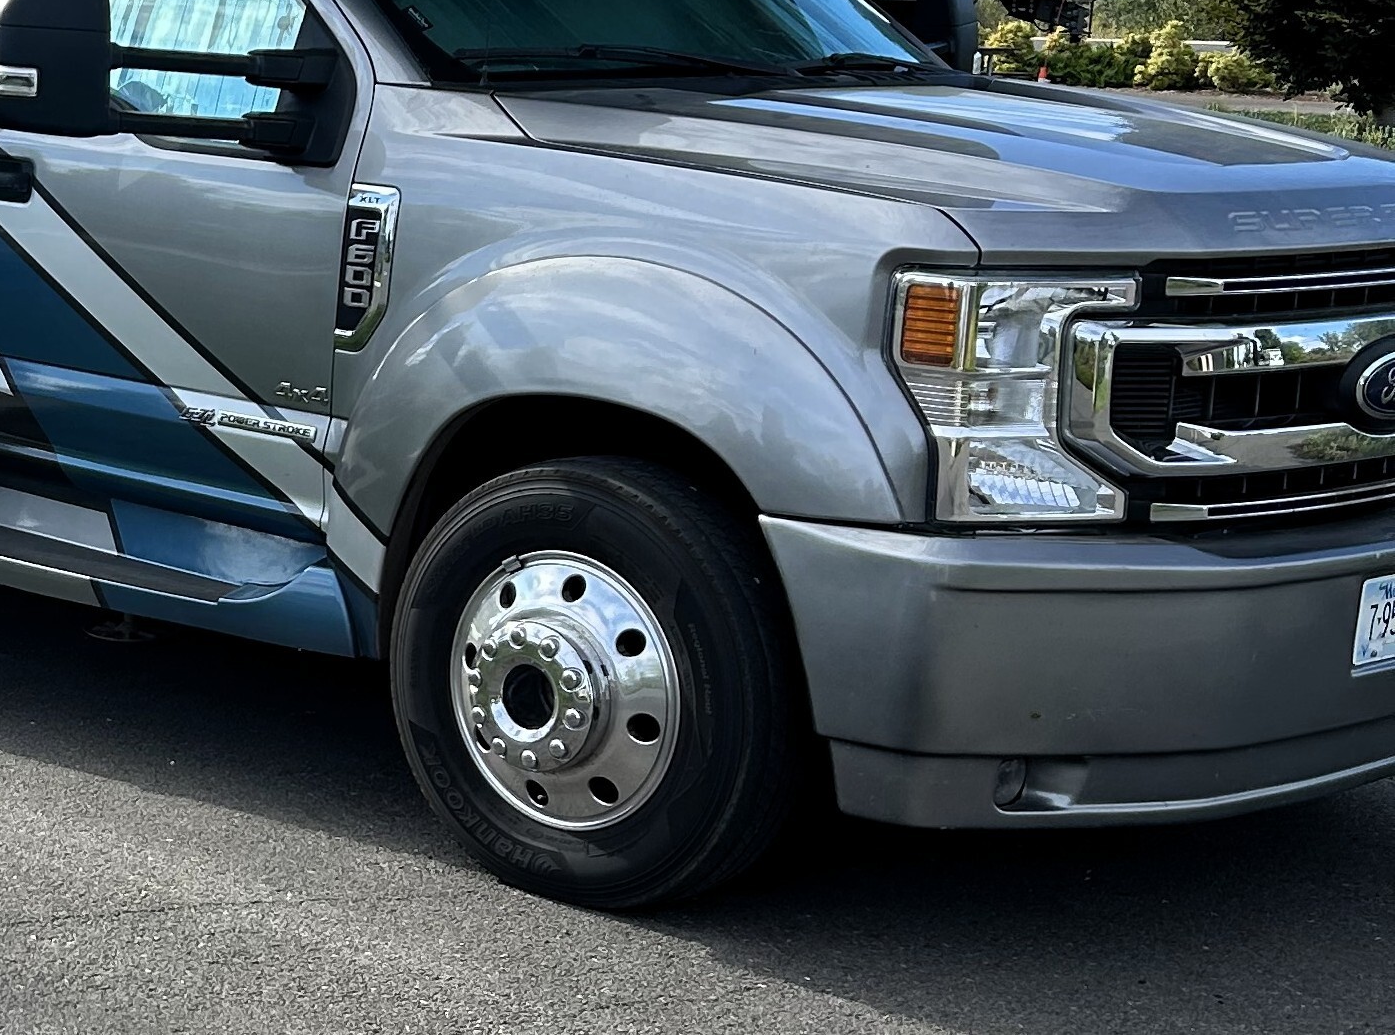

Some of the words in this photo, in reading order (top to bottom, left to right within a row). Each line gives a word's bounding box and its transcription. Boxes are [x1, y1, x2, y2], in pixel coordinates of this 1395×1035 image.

[359, 194, 381, 204] XLT
[342, 218, 381, 309] F600
[220, 412, 261, 427] POWER
[263, 421, 312, 437] STROKE
